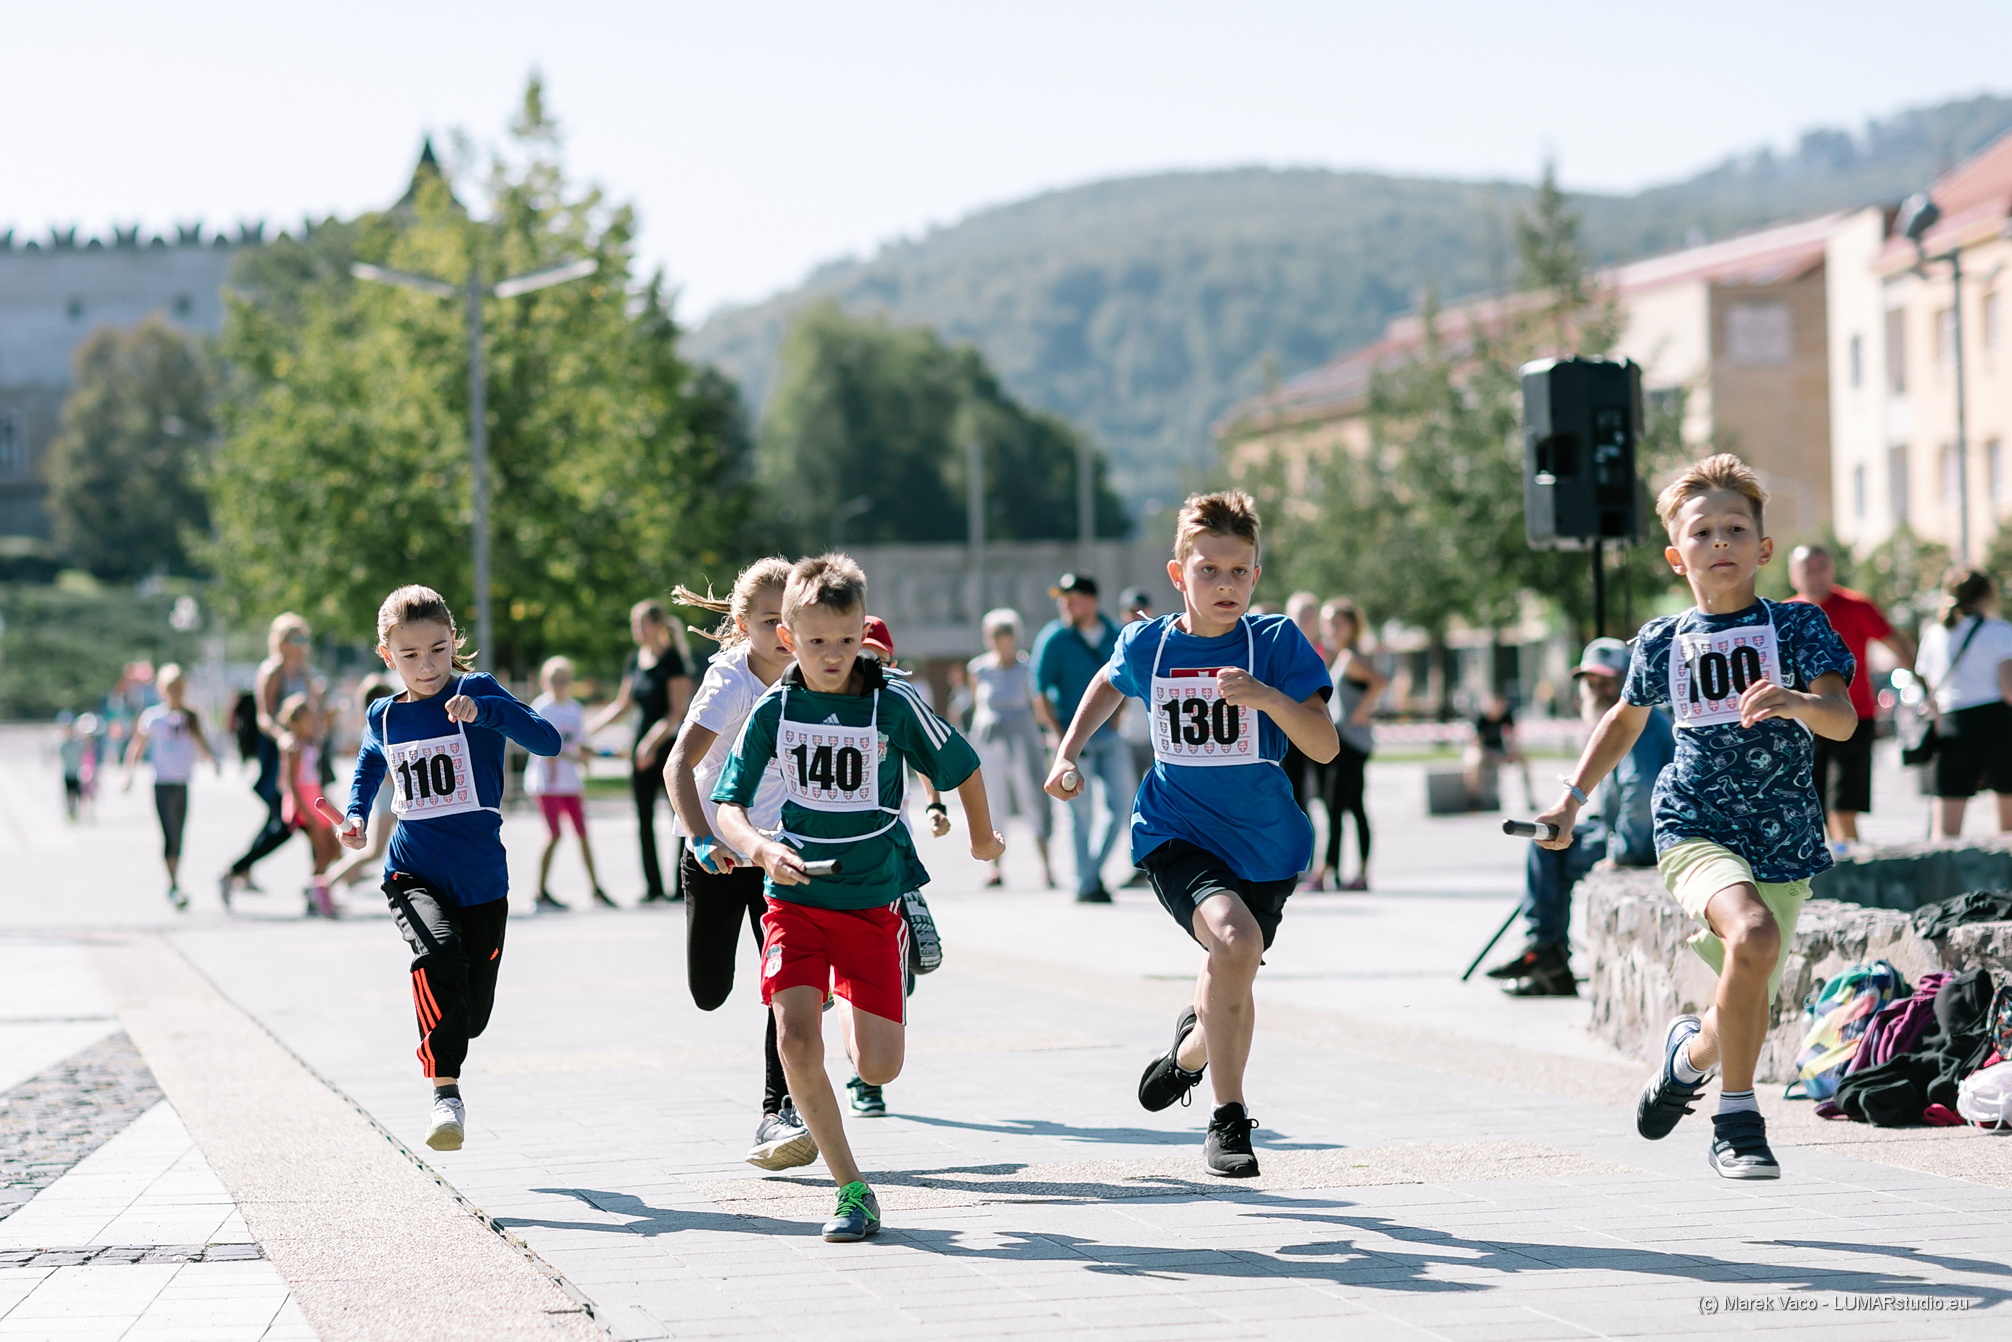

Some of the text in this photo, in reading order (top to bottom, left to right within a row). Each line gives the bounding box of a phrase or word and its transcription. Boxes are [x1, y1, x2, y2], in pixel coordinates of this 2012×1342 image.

[1685, 646, 1762, 704] 100
[1162, 698, 1240, 746] 130
[398, 754, 457, 801] 110
[791, 744, 863, 792] 140
